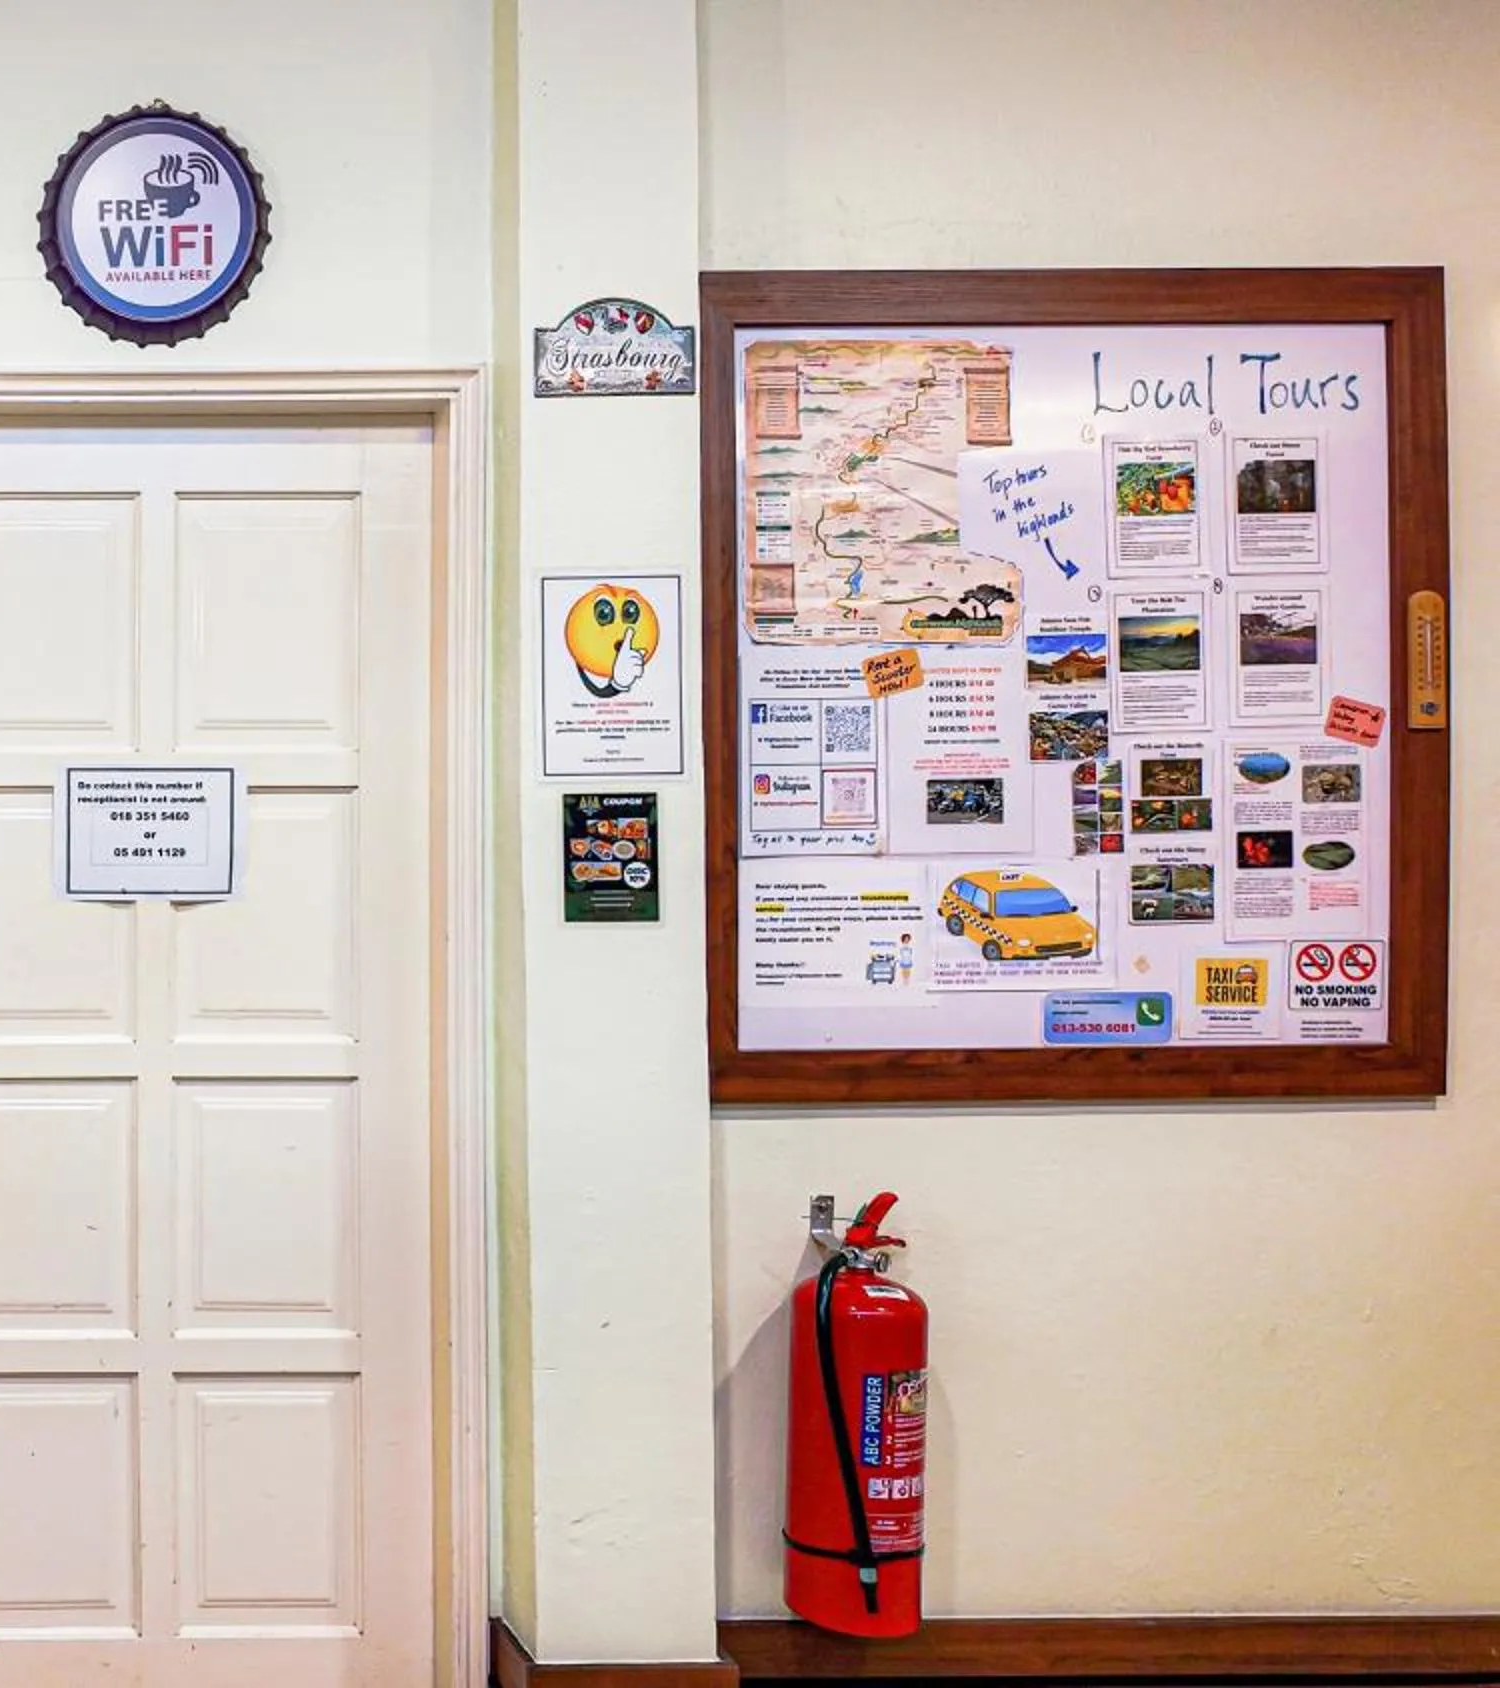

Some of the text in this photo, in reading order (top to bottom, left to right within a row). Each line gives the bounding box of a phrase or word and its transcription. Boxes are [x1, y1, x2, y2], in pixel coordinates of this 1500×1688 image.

[98, 200, 169, 221] FREE
[100, 224, 213, 267] WiFi
[105, 269, 212, 283] AVAILABLE HERE
[546, 338, 684, 380] Strasbourg
[1092, 351, 1360, 415] Local Tours
[983, 465, 1047, 501] Top tours
[992, 497, 1036, 523] in the
[769, 712, 812, 723] Facebook
[94, 781, 132, 790] contact
[134, 781, 153, 789] this
[155, 781, 193, 790] number
[195, 781, 203, 789] if
[772, 781, 812, 794] Instagram
[77, 795, 137, 805] receptionist
[151, 795, 167, 803] not
[110, 811, 132, 821] 018
[135, 811, 157, 821] 351
[143, 831, 157, 839] or
[113, 848, 129, 857] 05
[157, 848, 187, 857] 1129
[1206, 967, 1232, 984] TAXI
[1206, 986, 1257, 1003] SERVICE
[1295, 984, 1377, 995] NO SMOKING
[1300, 997, 1371, 1007] NO VAPING
[1051, 1023, 1102, 1034] 013-530
[864, 1377, 883, 1465] ABC POWDER
